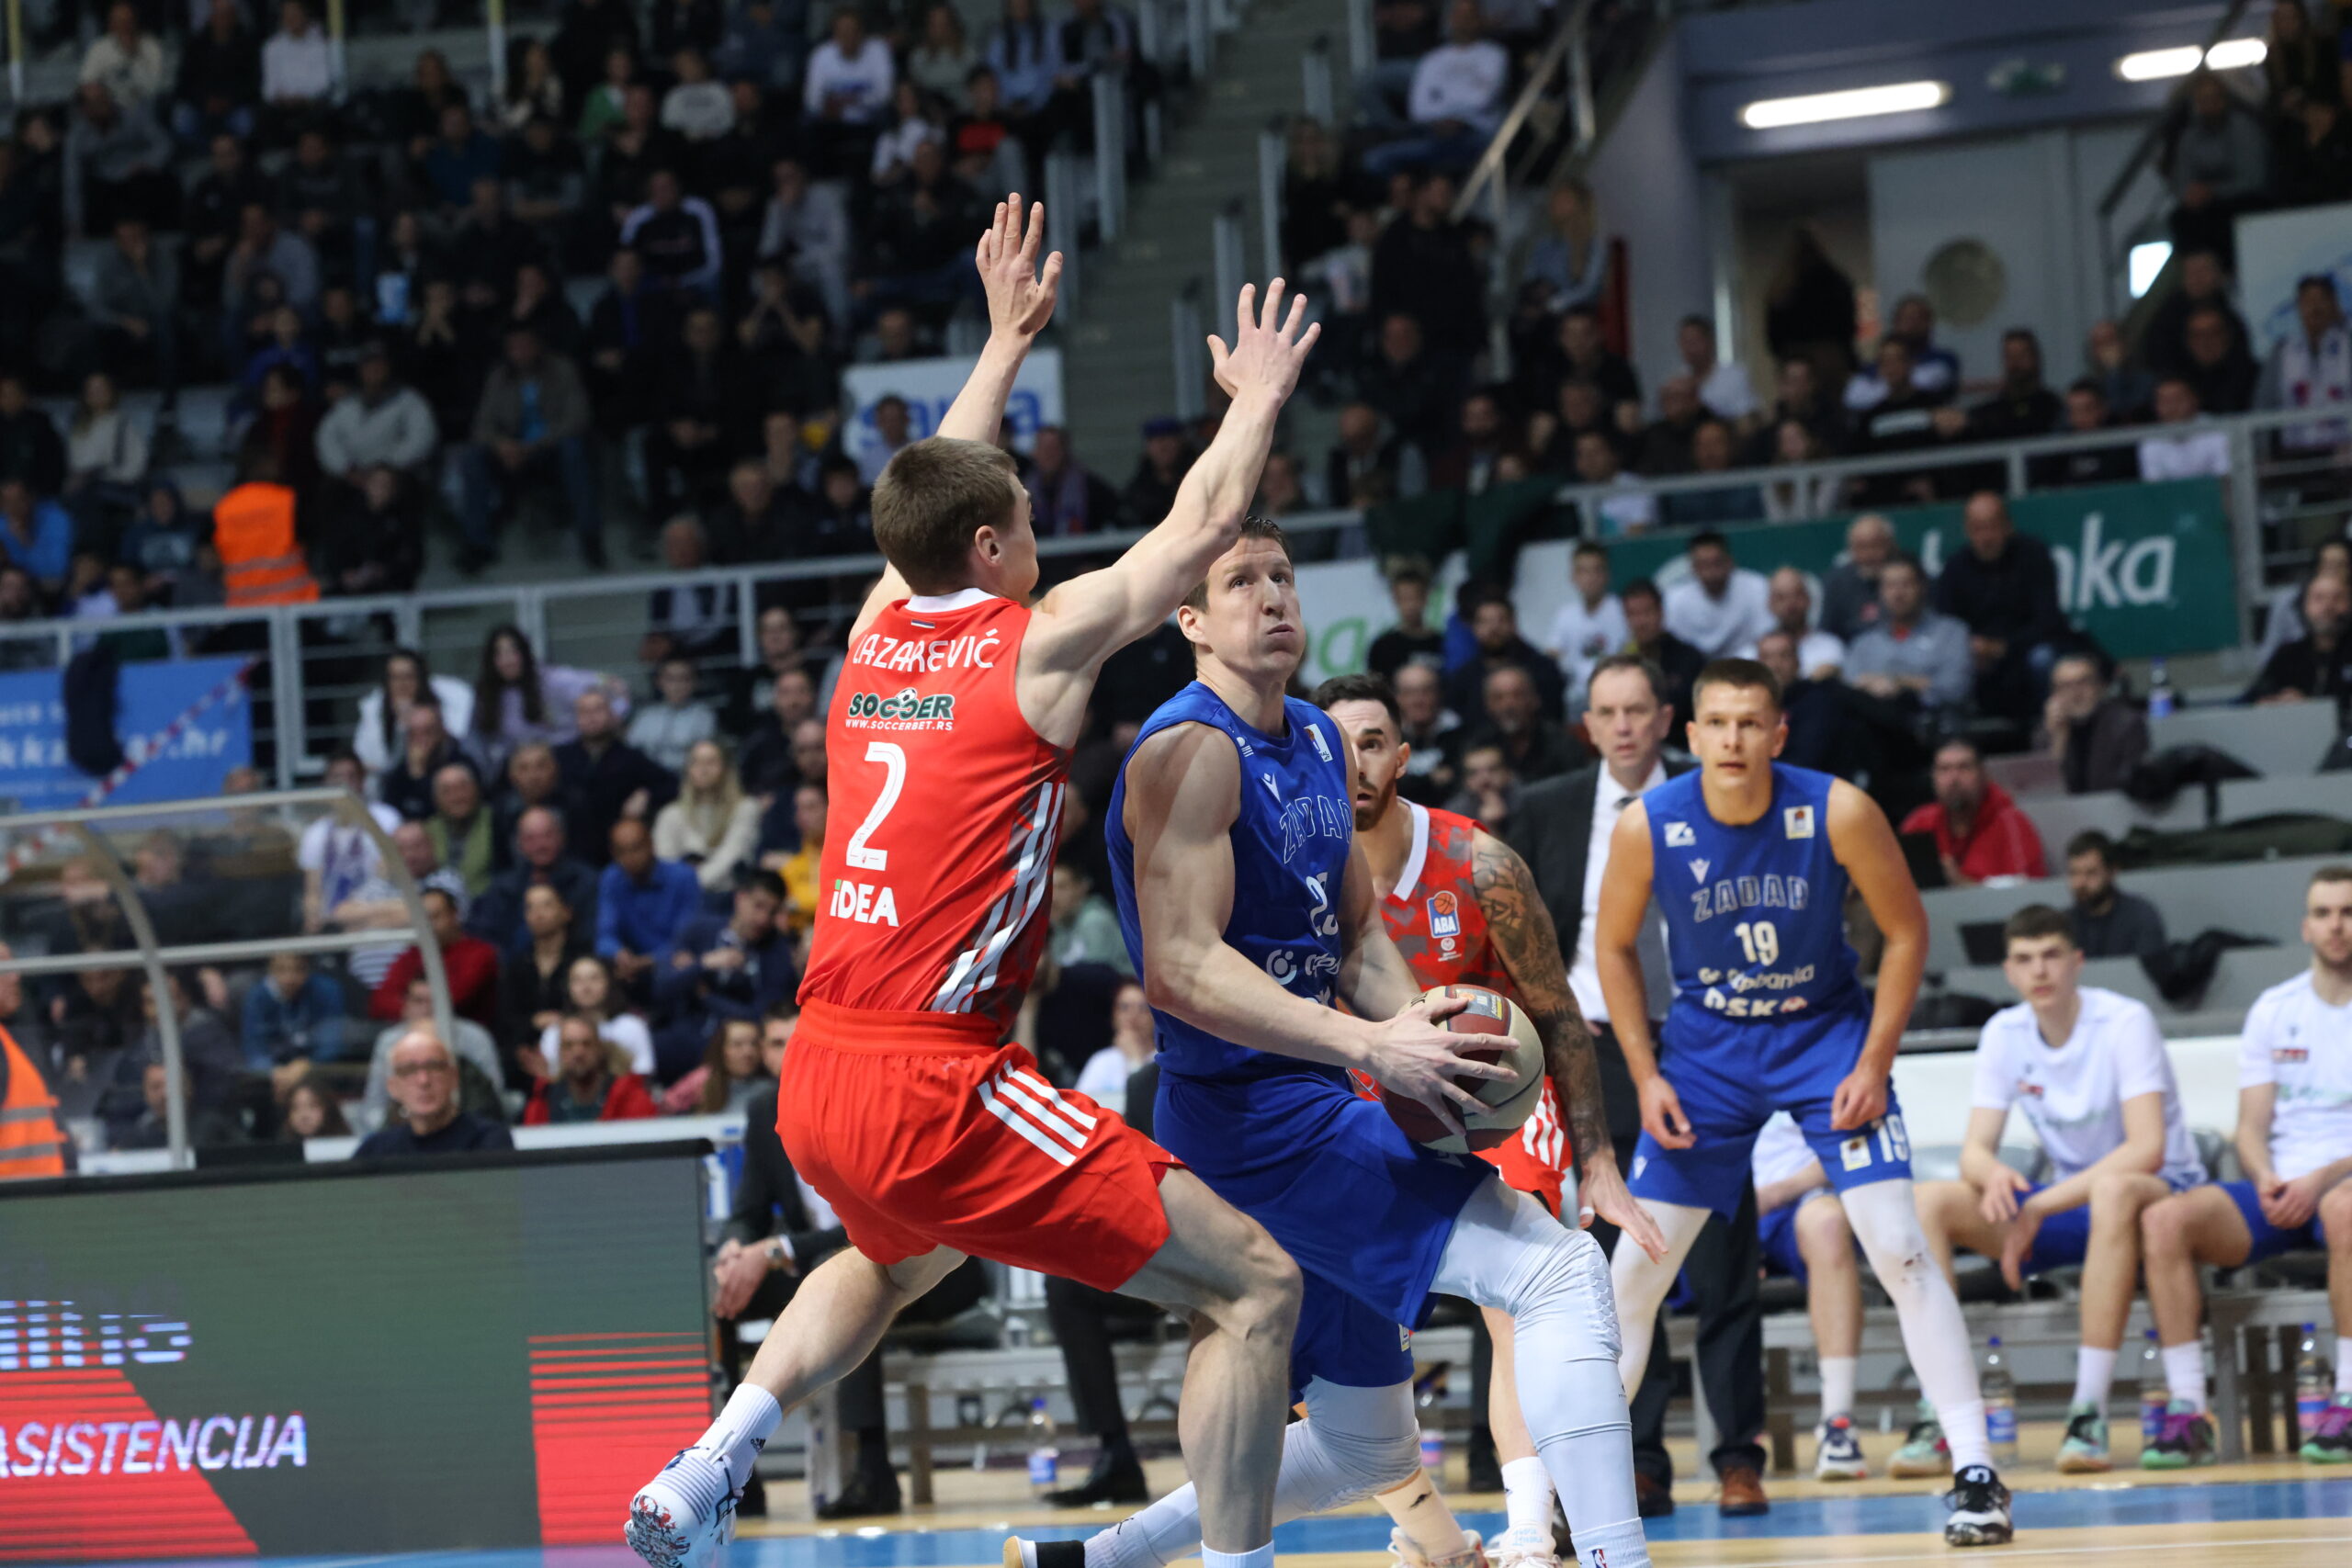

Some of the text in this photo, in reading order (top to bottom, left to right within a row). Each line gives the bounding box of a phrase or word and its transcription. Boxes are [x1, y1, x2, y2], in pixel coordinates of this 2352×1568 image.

[853, 628, 1000, 672] LAZAREVIĆ
[845, 719, 953, 731] WWW.SOCCERBET.RS
[848, 694, 955, 720] SOCCER
[846, 741, 907, 871] 2
[1434, 916, 1456, 934] ABA
[1735, 920, 1779, 966] 19
[1871, 1114, 1909, 1163] 19
